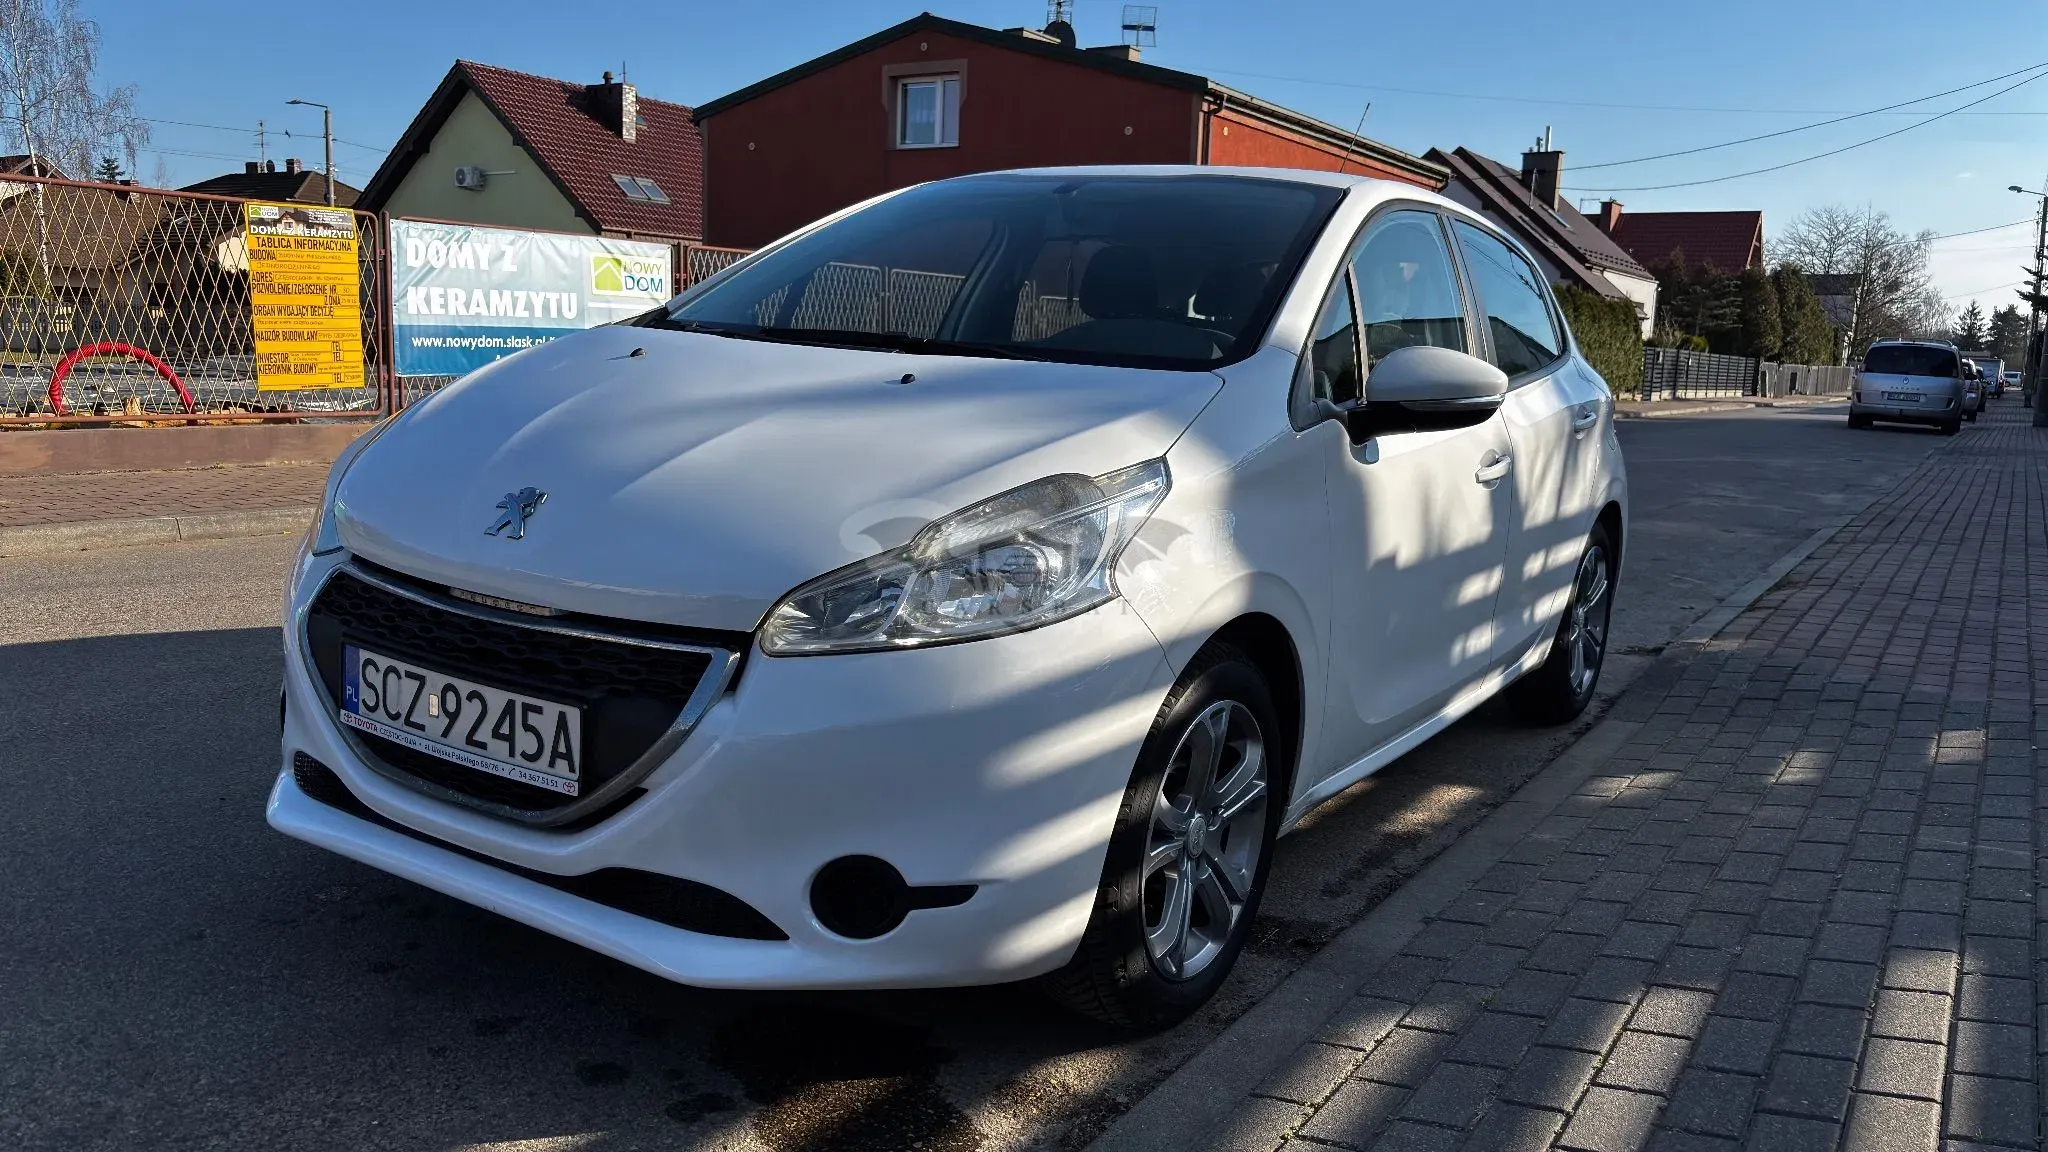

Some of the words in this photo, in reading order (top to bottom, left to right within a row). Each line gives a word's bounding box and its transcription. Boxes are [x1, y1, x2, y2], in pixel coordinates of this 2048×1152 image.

[250, 225, 283, 235] DOMY
[297, 226, 354, 239] KERAMZYTU
[255, 237, 292, 249] TABLICA
[294, 238, 352, 251] INFORMACYJNA
[249, 249, 277, 260] BUDOWA
[406, 237, 496, 271] DOMY
[501, 245, 518, 272] Z
[624, 259, 662, 275] NOWY
[251, 271, 273, 283] ADRES
[624, 275, 664, 294] DOM
[406, 286, 578, 319] KERAMZYTU
[253, 305, 276, 316] ORGAN
[255, 330, 280, 341] NADZÓR
[281, 330, 318, 341] BUDOWLANY
[411, 335, 546, 350] www.nowydom.slask.pl
[257, 352, 289, 363] INWESTOR
[258, 363, 292, 375] KIEROWNIK
[293, 363, 317, 374] BUDOWY
[346, 685, 358, 702] PL
[361, 657, 427, 732] SCZ
[440, 682, 577, 774] 9245A
[354, 716, 378, 732] TOYOTA
[518, 770, 526, 779] 34
